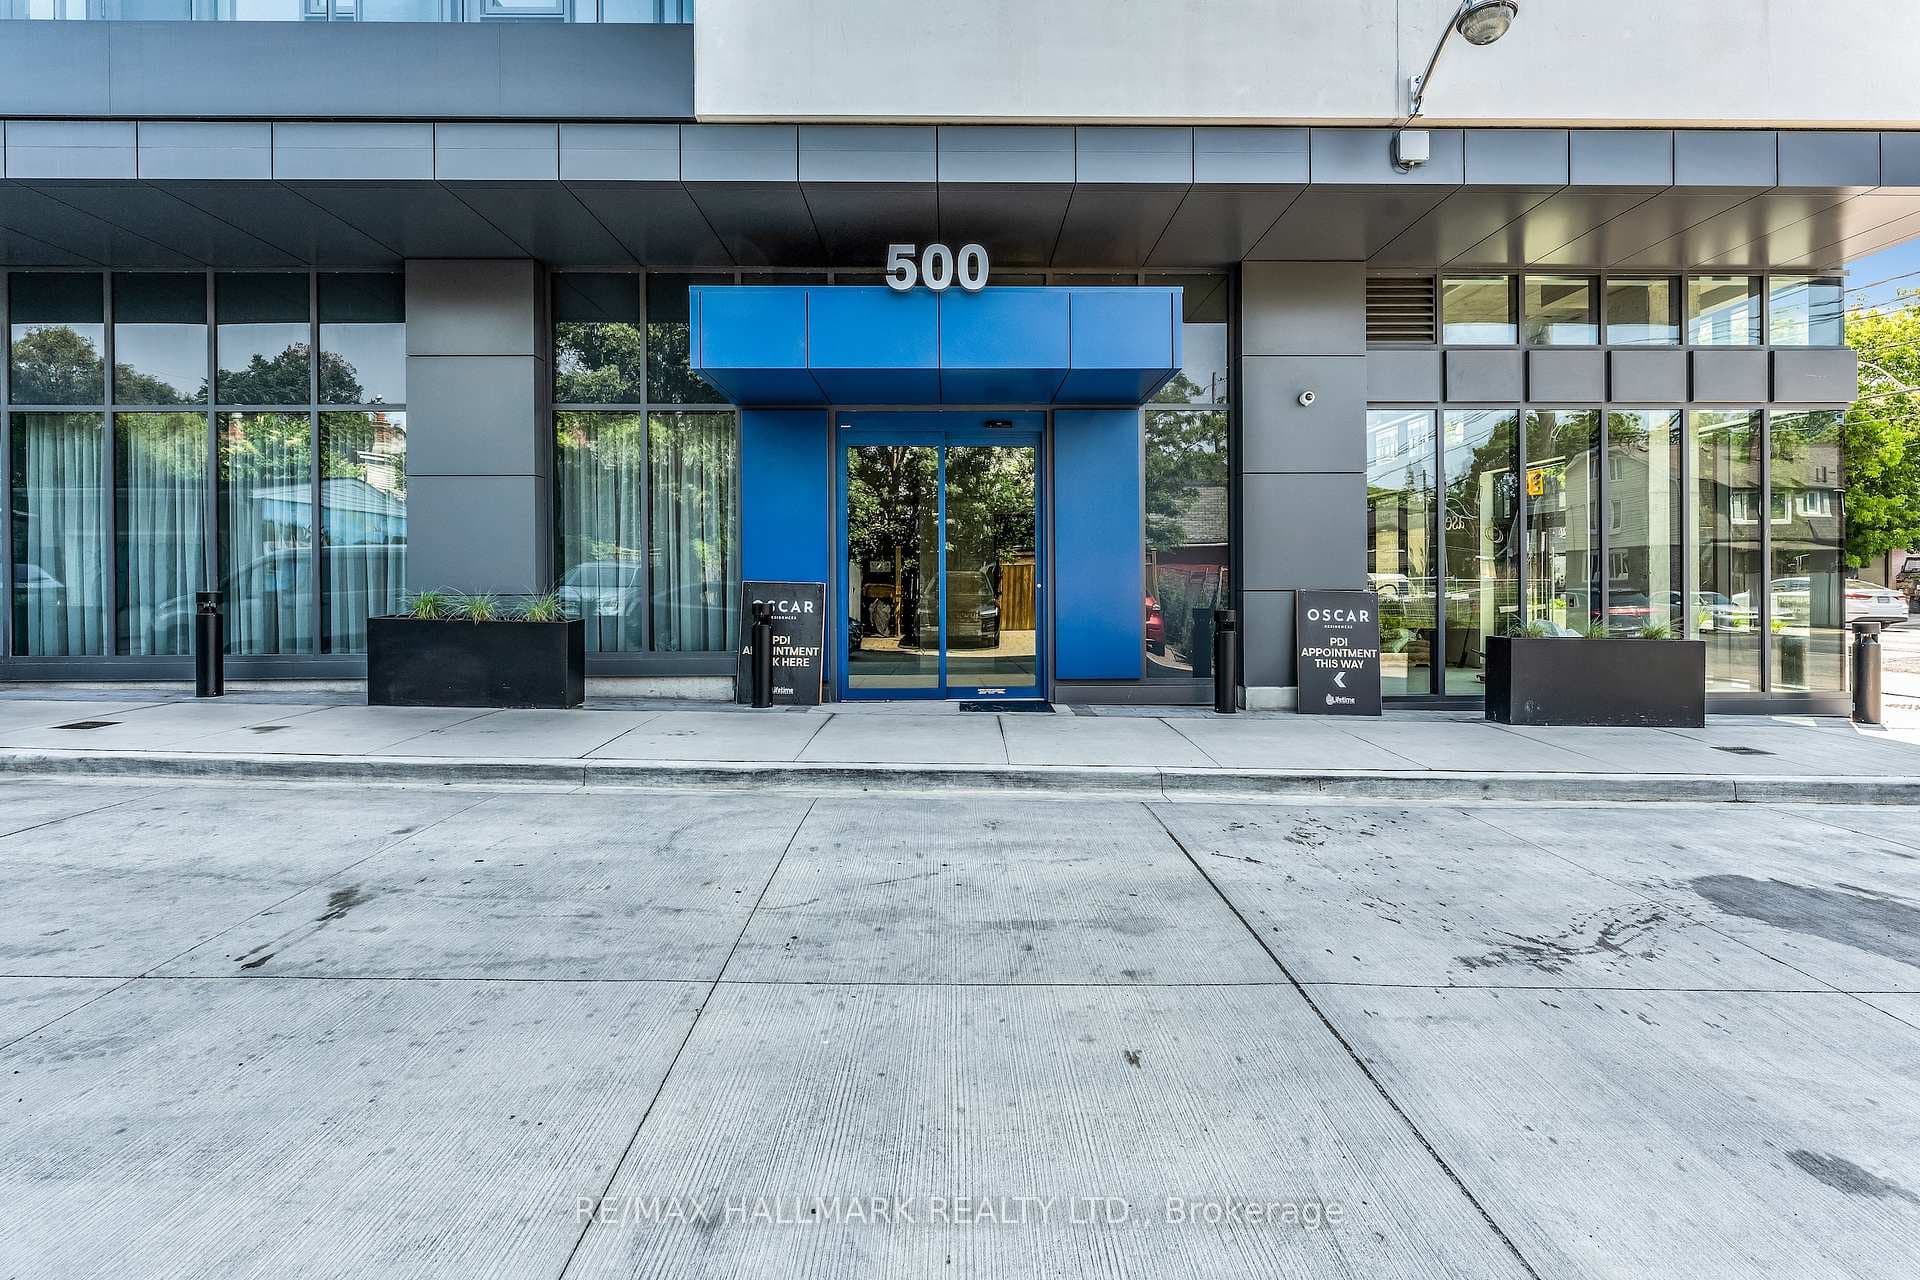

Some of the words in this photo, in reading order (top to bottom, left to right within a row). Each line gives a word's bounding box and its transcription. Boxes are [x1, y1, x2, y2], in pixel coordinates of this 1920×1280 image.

[885, 243, 989, 292] 500
[752, 600, 814, 613] SCAR
[1307, 609, 1370, 622] OSCAR
[772, 635, 790, 645] PDI
[1330, 637, 1348, 647] PDI
[742, 646, 819, 656] AINTMENT
[1301, 647, 1377, 658] APPOINTMENT
[782, 658, 810, 667] HERE
[1315, 659, 1339, 668] THIS
[1340, 660, 1364, 669] WAY
